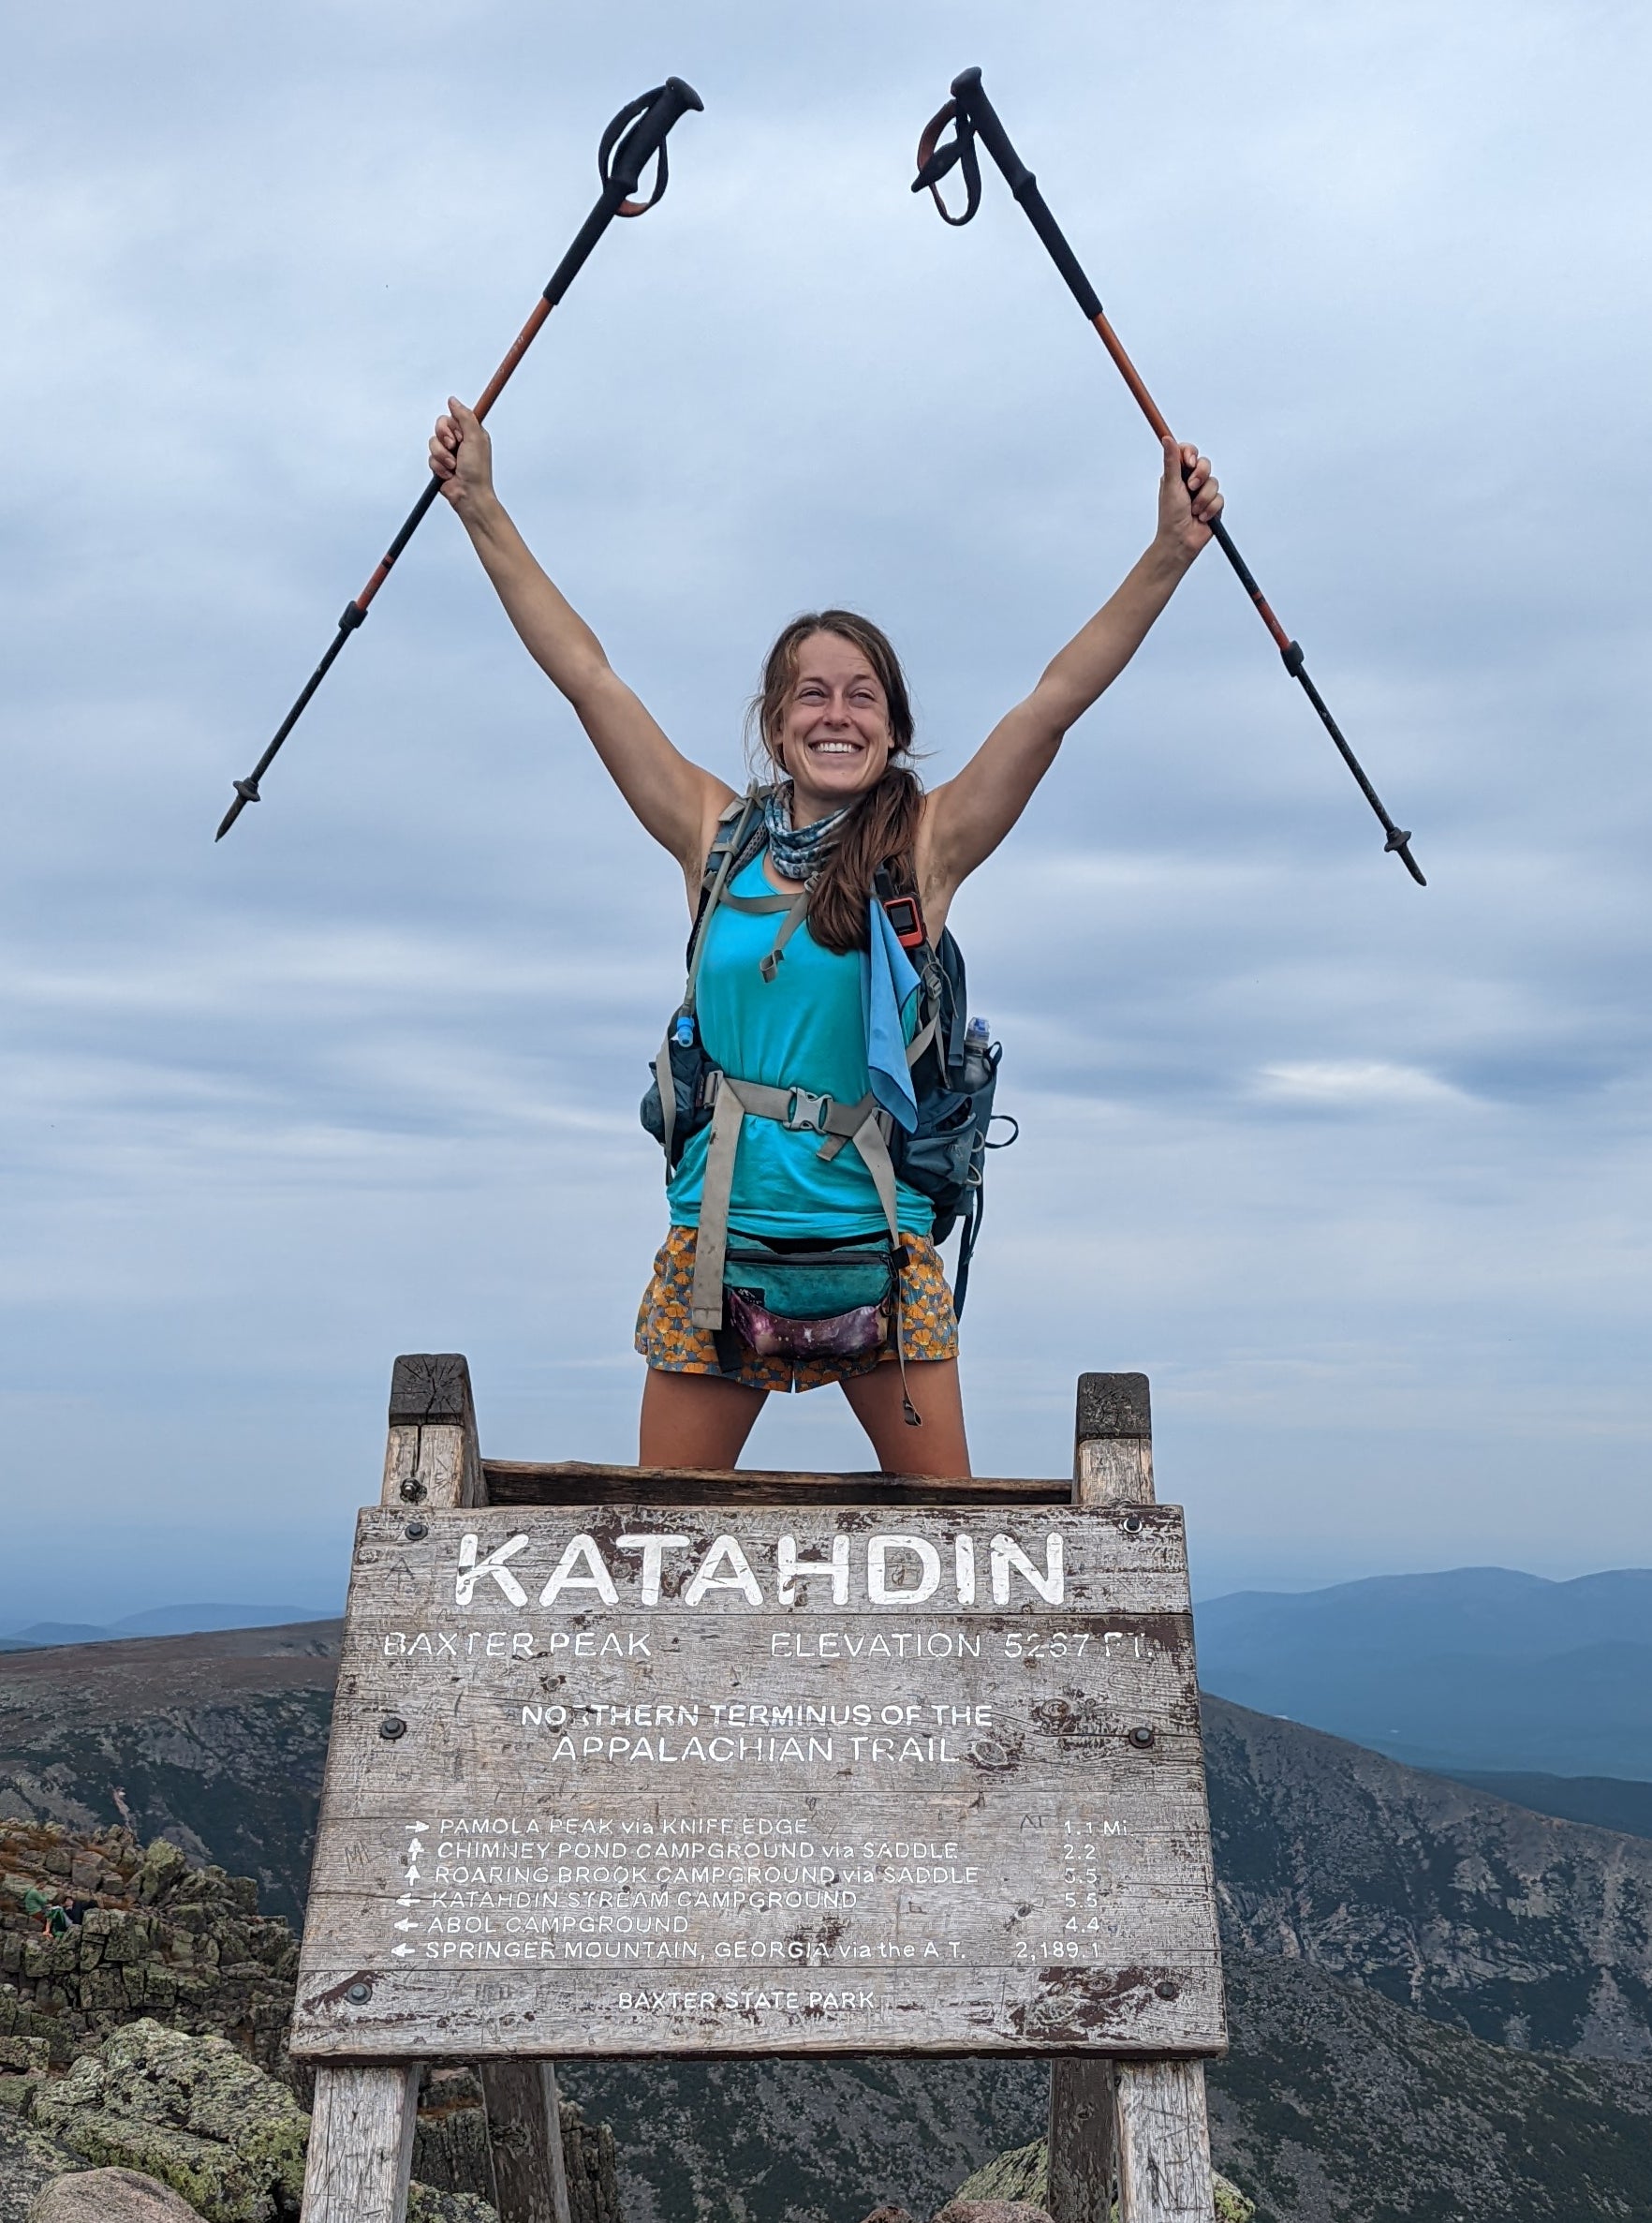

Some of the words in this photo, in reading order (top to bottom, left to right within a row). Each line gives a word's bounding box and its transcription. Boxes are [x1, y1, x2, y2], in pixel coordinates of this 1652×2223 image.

[455, 1532, 1065, 1608] KATAHDIN
[384, 1631, 534, 1656] BAXTER
[550, 1632, 652, 1657] PEAK
[771, 1632, 981, 1658] ELEVATION
[709, 1704, 872, 1727] TERMINUS
[880, 1704, 922, 1726] OF
[931, 1704, 993, 1727] THE
[552, 1736, 833, 1763] APPALACHIAN
[848, 1736, 960, 1763] TRAIL
[440, 1817, 540, 1834] PAMOLA
[549, 1818, 613, 1835] PEAK
[620, 1819, 654, 1835] via
[662, 1817, 733, 1835] KNIFE
[742, 1817, 808, 1835] EDGE
[1064, 1819, 1093, 1835] 1.1
[1103, 1819, 1134, 1837] Mi.
[437, 1841, 551, 1860] CHIMNEY
[557, 1842, 627, 1859] POND
[636, 1842, 815, 1860] CAMPGROUND
[821, 1842, 855, 1859] via
[863, 1842, 959, 1860] SADDLE
[1063, 1844, 1097, 1860] 2.2
[435, 1864, 549, 1884] ROARING
[558, 1865, 647, 1884] BROOK
[656, 1866, 835, 1884] CAMPGROUND
[842, 1866, 875, 1884] via
[883, 1866, 979, 1884] SADDLE
[1064, 1867, 1098, 1884] 5.5
[432, 1890, 558, 1908] KATAHDIN
[568, 1890, 669, 1908] STREAM
[677, 1890, 857, 1909] CAMPGROUND
[1065, 1891, 1098, 1908] 5.5
[427, 1916, 497, 1934] ABOL
[506, 1915, 688, 1934] CAMPGROUND
[1065, 1916, 1100, 1933] 4.4
[425, 1940, 555, 1960] SPRINGER
[564, 1940, 707, 1963] MOUNTAIN,
[715, 1940, 830, 1959] GEORGIA
[838, 1941, 872, 1958] via
[877, 1941, 915, 1958] the
[1015, 1941, 1099, 1962] 2,189.1
[618, 1992, 715, 2009] BAXTER
[725, 1991, 800, 2009] STATE
[809, 1991, 875, 2009] PARK
